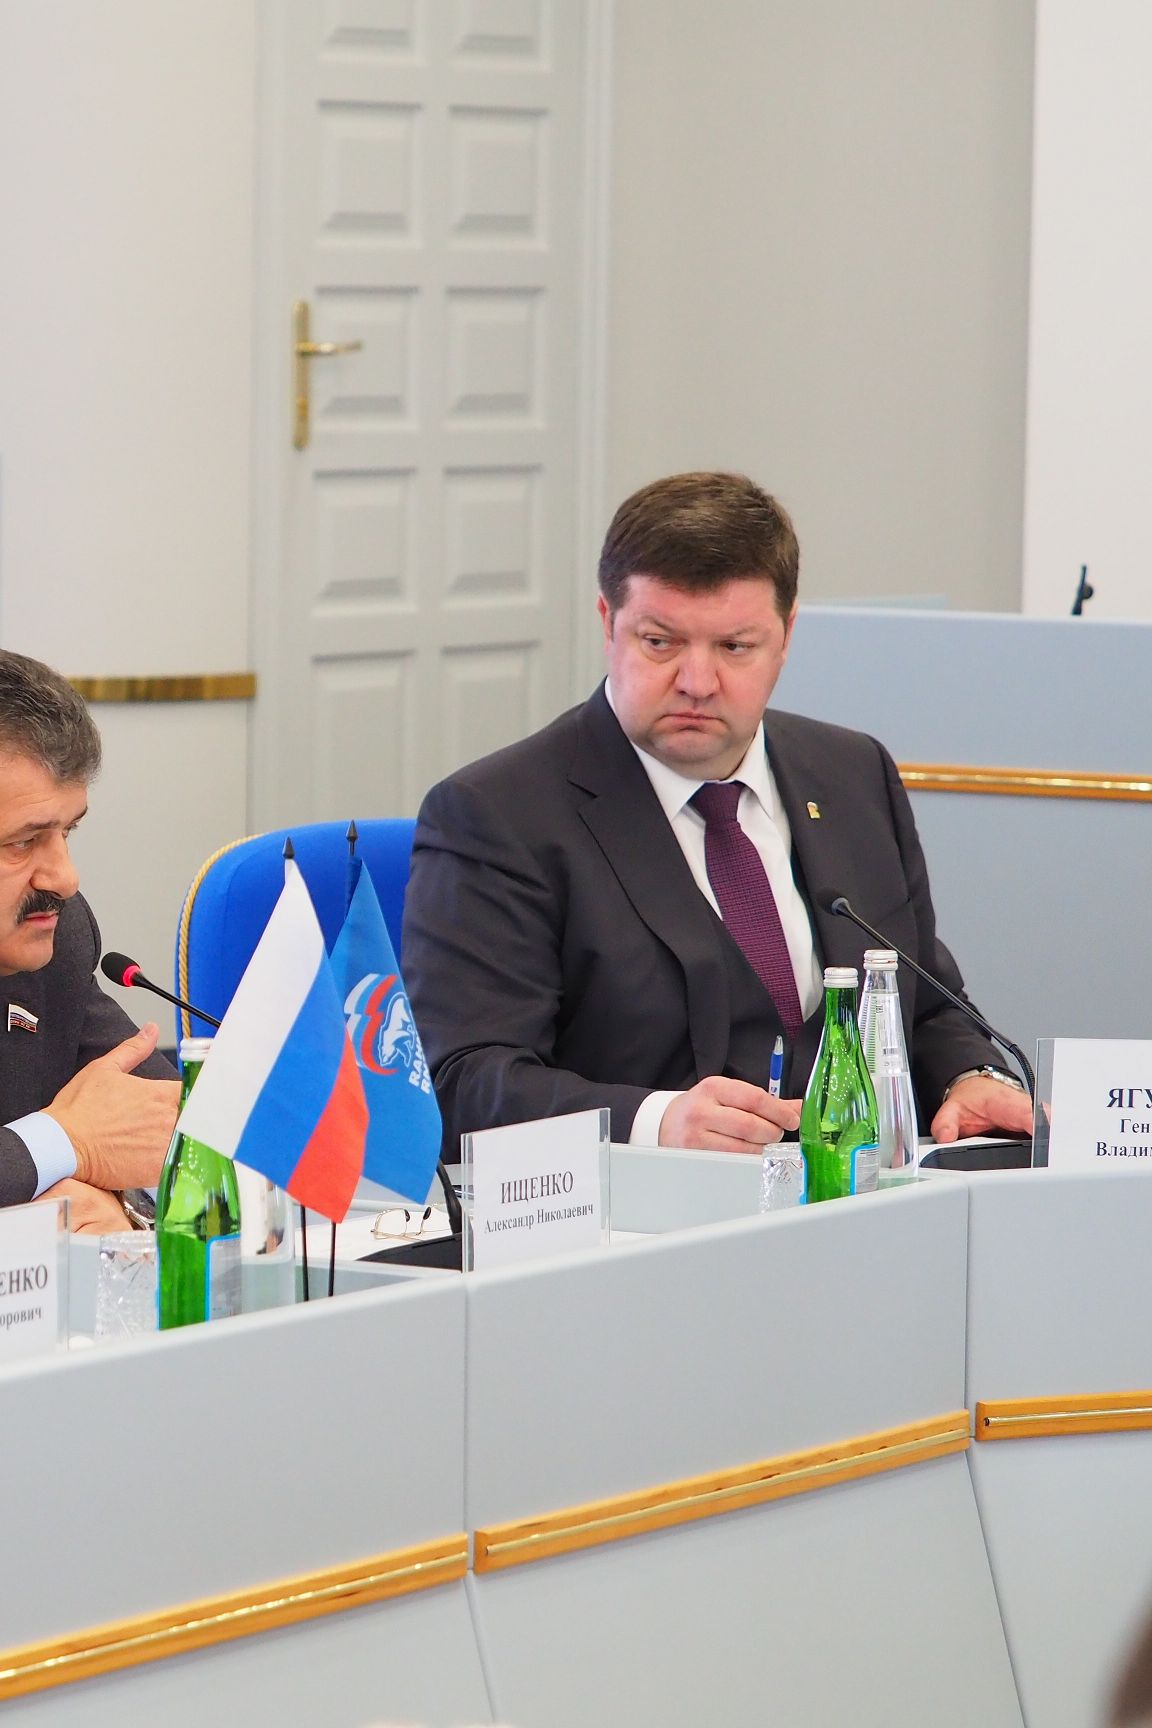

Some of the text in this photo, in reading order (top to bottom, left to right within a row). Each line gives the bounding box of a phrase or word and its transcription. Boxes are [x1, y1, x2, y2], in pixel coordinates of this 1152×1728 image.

[501, 1171, 573, 1203] ИЩЕНКО
[485, 1204, 593, 1233] Александр Николаевич
